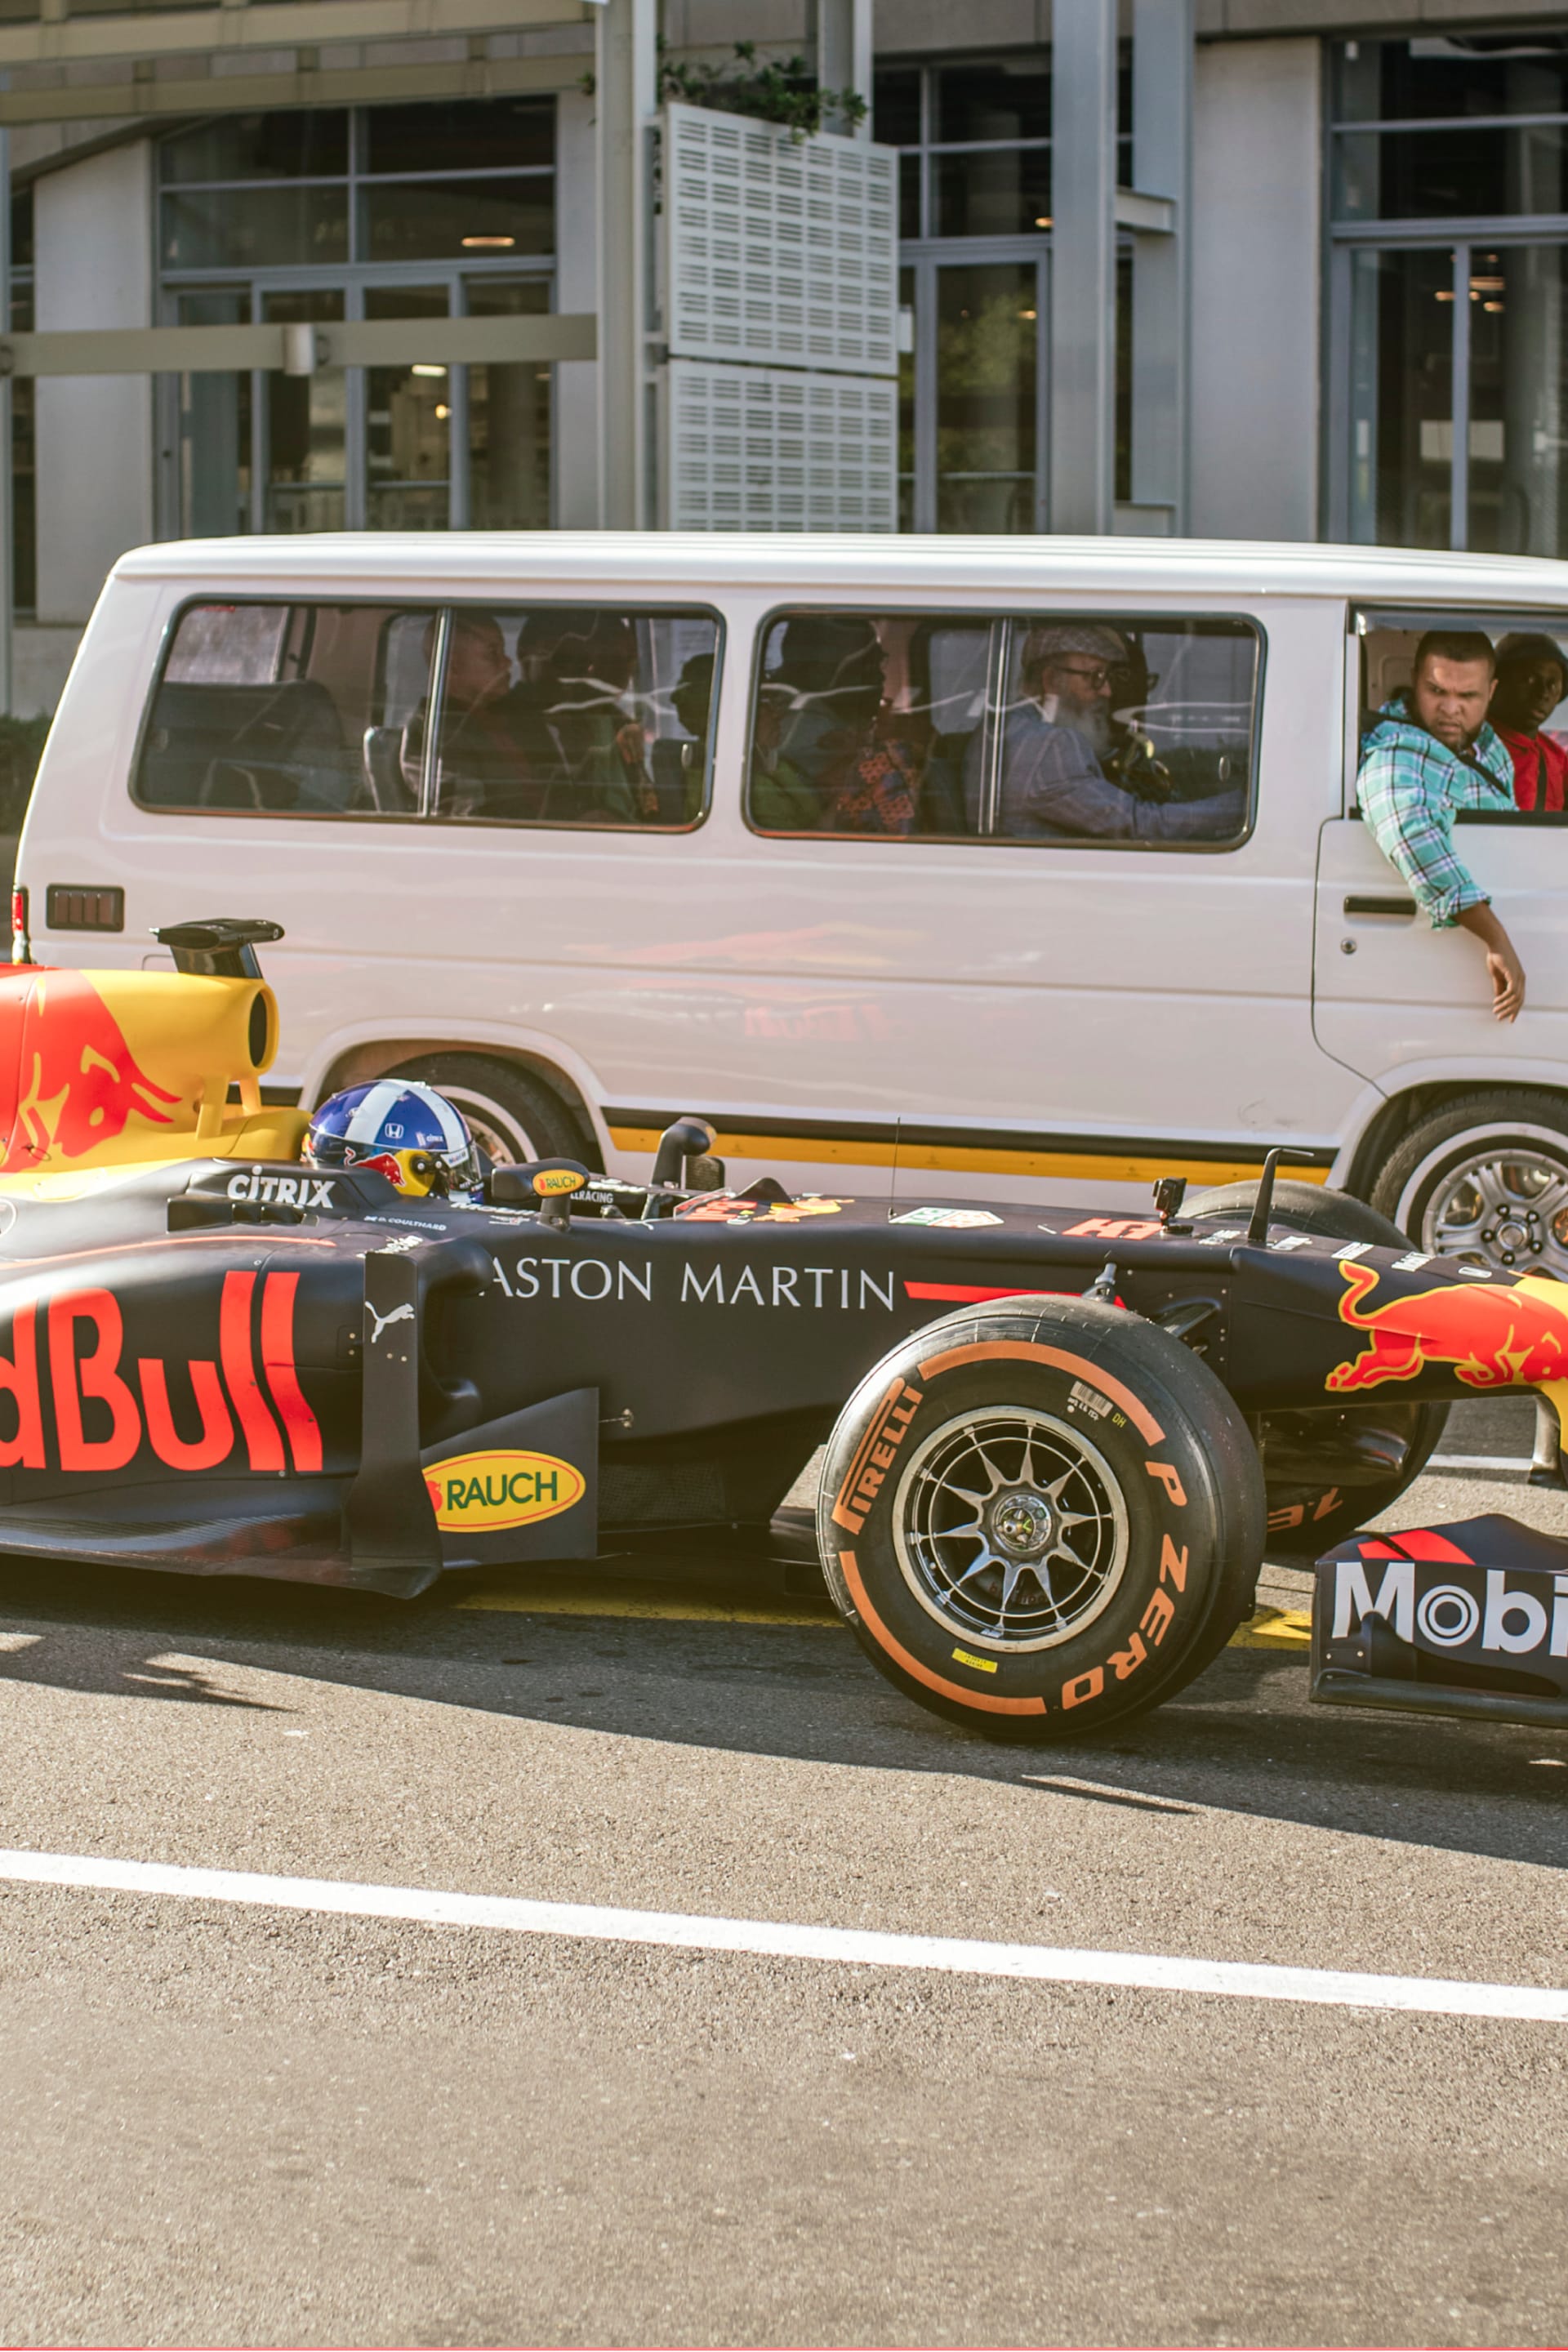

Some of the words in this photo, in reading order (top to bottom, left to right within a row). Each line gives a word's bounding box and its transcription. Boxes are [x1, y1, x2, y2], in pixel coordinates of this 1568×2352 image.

[545, 1176, 577, 1189] RAUCH
[388, 1217, 447, 1232] COULTHARD
[680, 1262, 893, 1312] MARTIN
[1111, 1412, 1127, 1428] DH
[831, 1377, 924, 1535] PIRELLI
[447, 1471, 558, 1511] RAUCH
[1145, 1461, 1187, 1506] P
[1062, 1534, 1189, 1710] ZERO
[1332, 1561, 1568, 1657] Mobi
